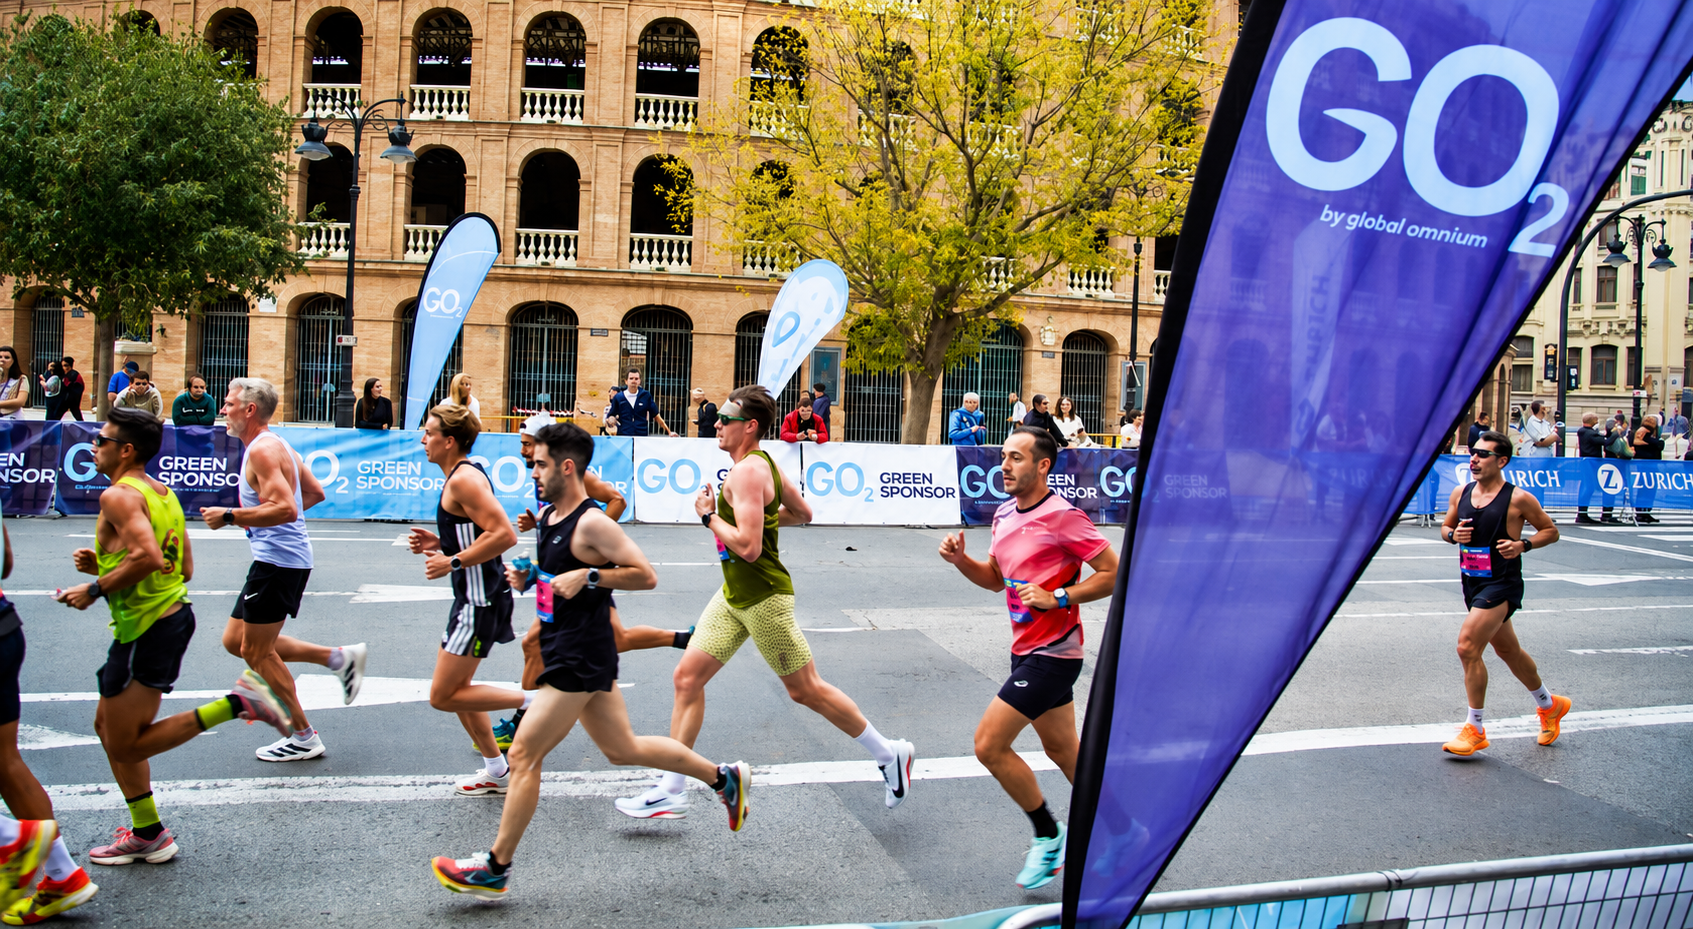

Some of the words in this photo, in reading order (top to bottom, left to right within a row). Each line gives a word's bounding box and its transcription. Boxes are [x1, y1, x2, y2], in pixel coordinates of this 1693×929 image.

[1320, 203, 1345, 228] by
[1346, 210, 1406, 235] global
[1406, 226, 1488, 248] omnium
[159, 456, 228, 471] GREEN
[357, 460, 422, 475] GREEN
[0, 468, 56, 483] NSOR
[297, 449, 349, 494] O2
[637, 458, 704, 495] GO
[880, 472, 933, 484] GREEN
[1501, 469, 1561, 488] URICH
[158, 472, 240, 487] SPONSO
[356, 475, 445, 491] SPONSOR
[960, 464, 1011, 499] GO
[1047, 474, 1075, 486] EEN
[1164, 474, 1208, 486] GREEN
[1630, 471, 1693, 490] ZURICH
[880, 486, 956, 498] SPONSOR
[1048, 486, 1097, 499] NSOR
[1165, 487, 1228, 499] SPONSOR
